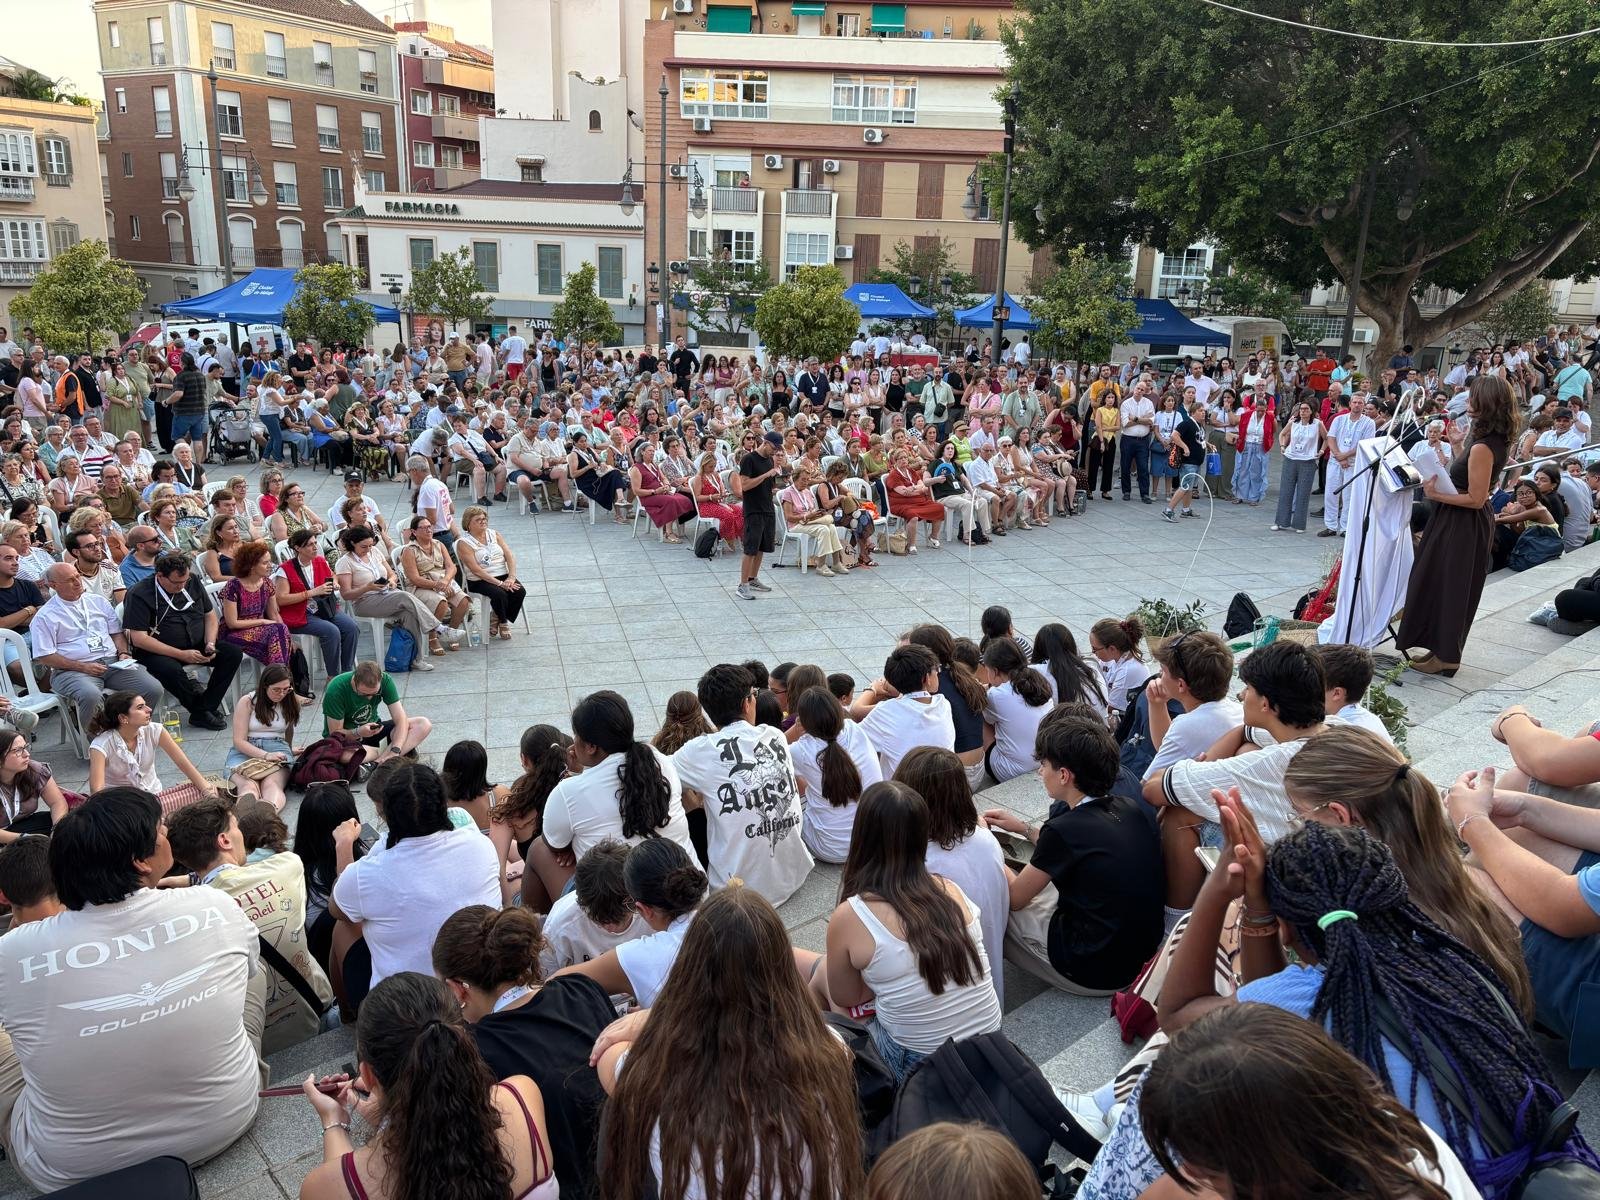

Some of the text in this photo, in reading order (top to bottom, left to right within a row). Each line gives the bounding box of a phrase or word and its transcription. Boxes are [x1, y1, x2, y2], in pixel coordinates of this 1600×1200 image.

[384, 201, 460, 215] FARMACIA
[1240, 339, 1256, 349] Hertz
[18, 906, 228, 983] HONDA
[79, 985, 218, 1037] GOLDWING
